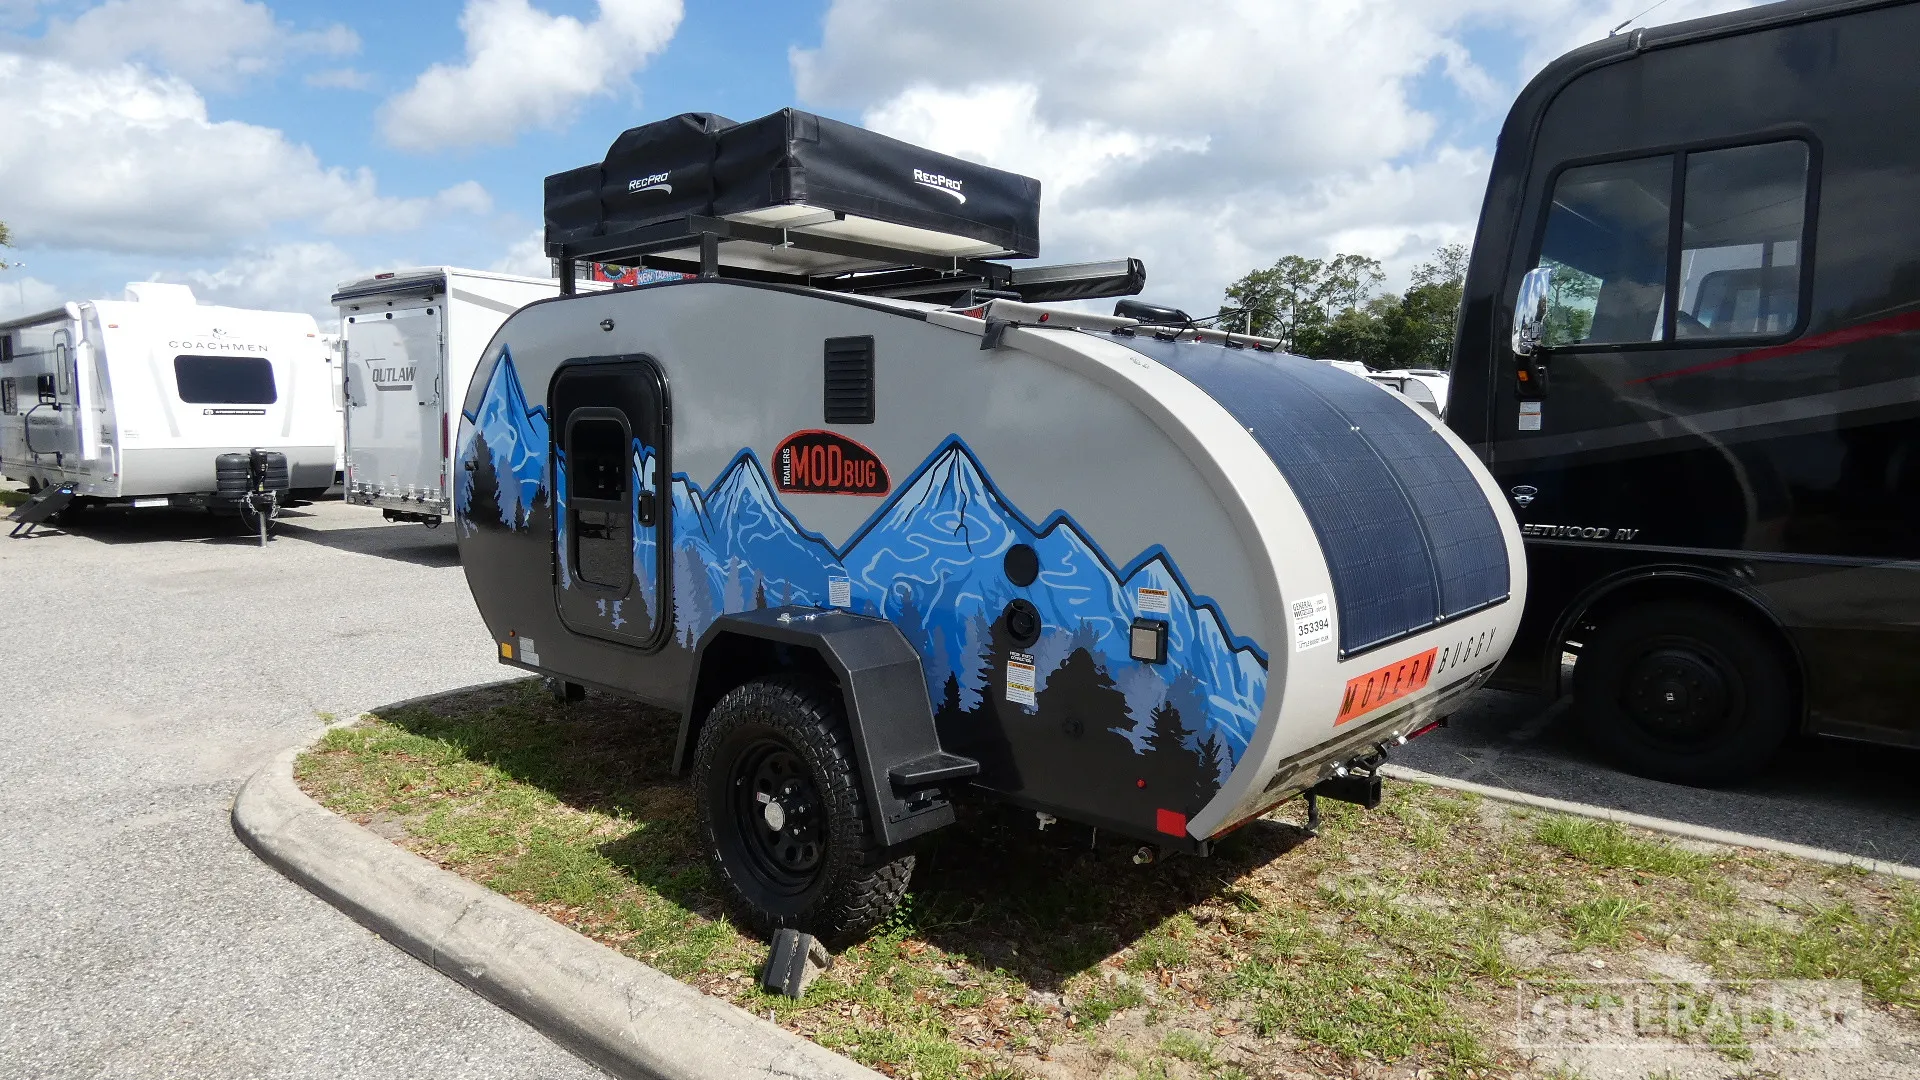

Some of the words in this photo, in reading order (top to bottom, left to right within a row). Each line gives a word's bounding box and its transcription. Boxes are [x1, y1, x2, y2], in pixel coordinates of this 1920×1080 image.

[168, 340, 268, 352] COACHMEN
[372, 366, 416, 382] OUTLAW
[783, 448, 791, 486] TRAILERS
[1614, 528, 1640, 541] RV
[1298, 617, 1329, 636] 353394
[1340, 653, 1435, 716] MODERN
[1438, 626, 1497, 674] BUGGY
